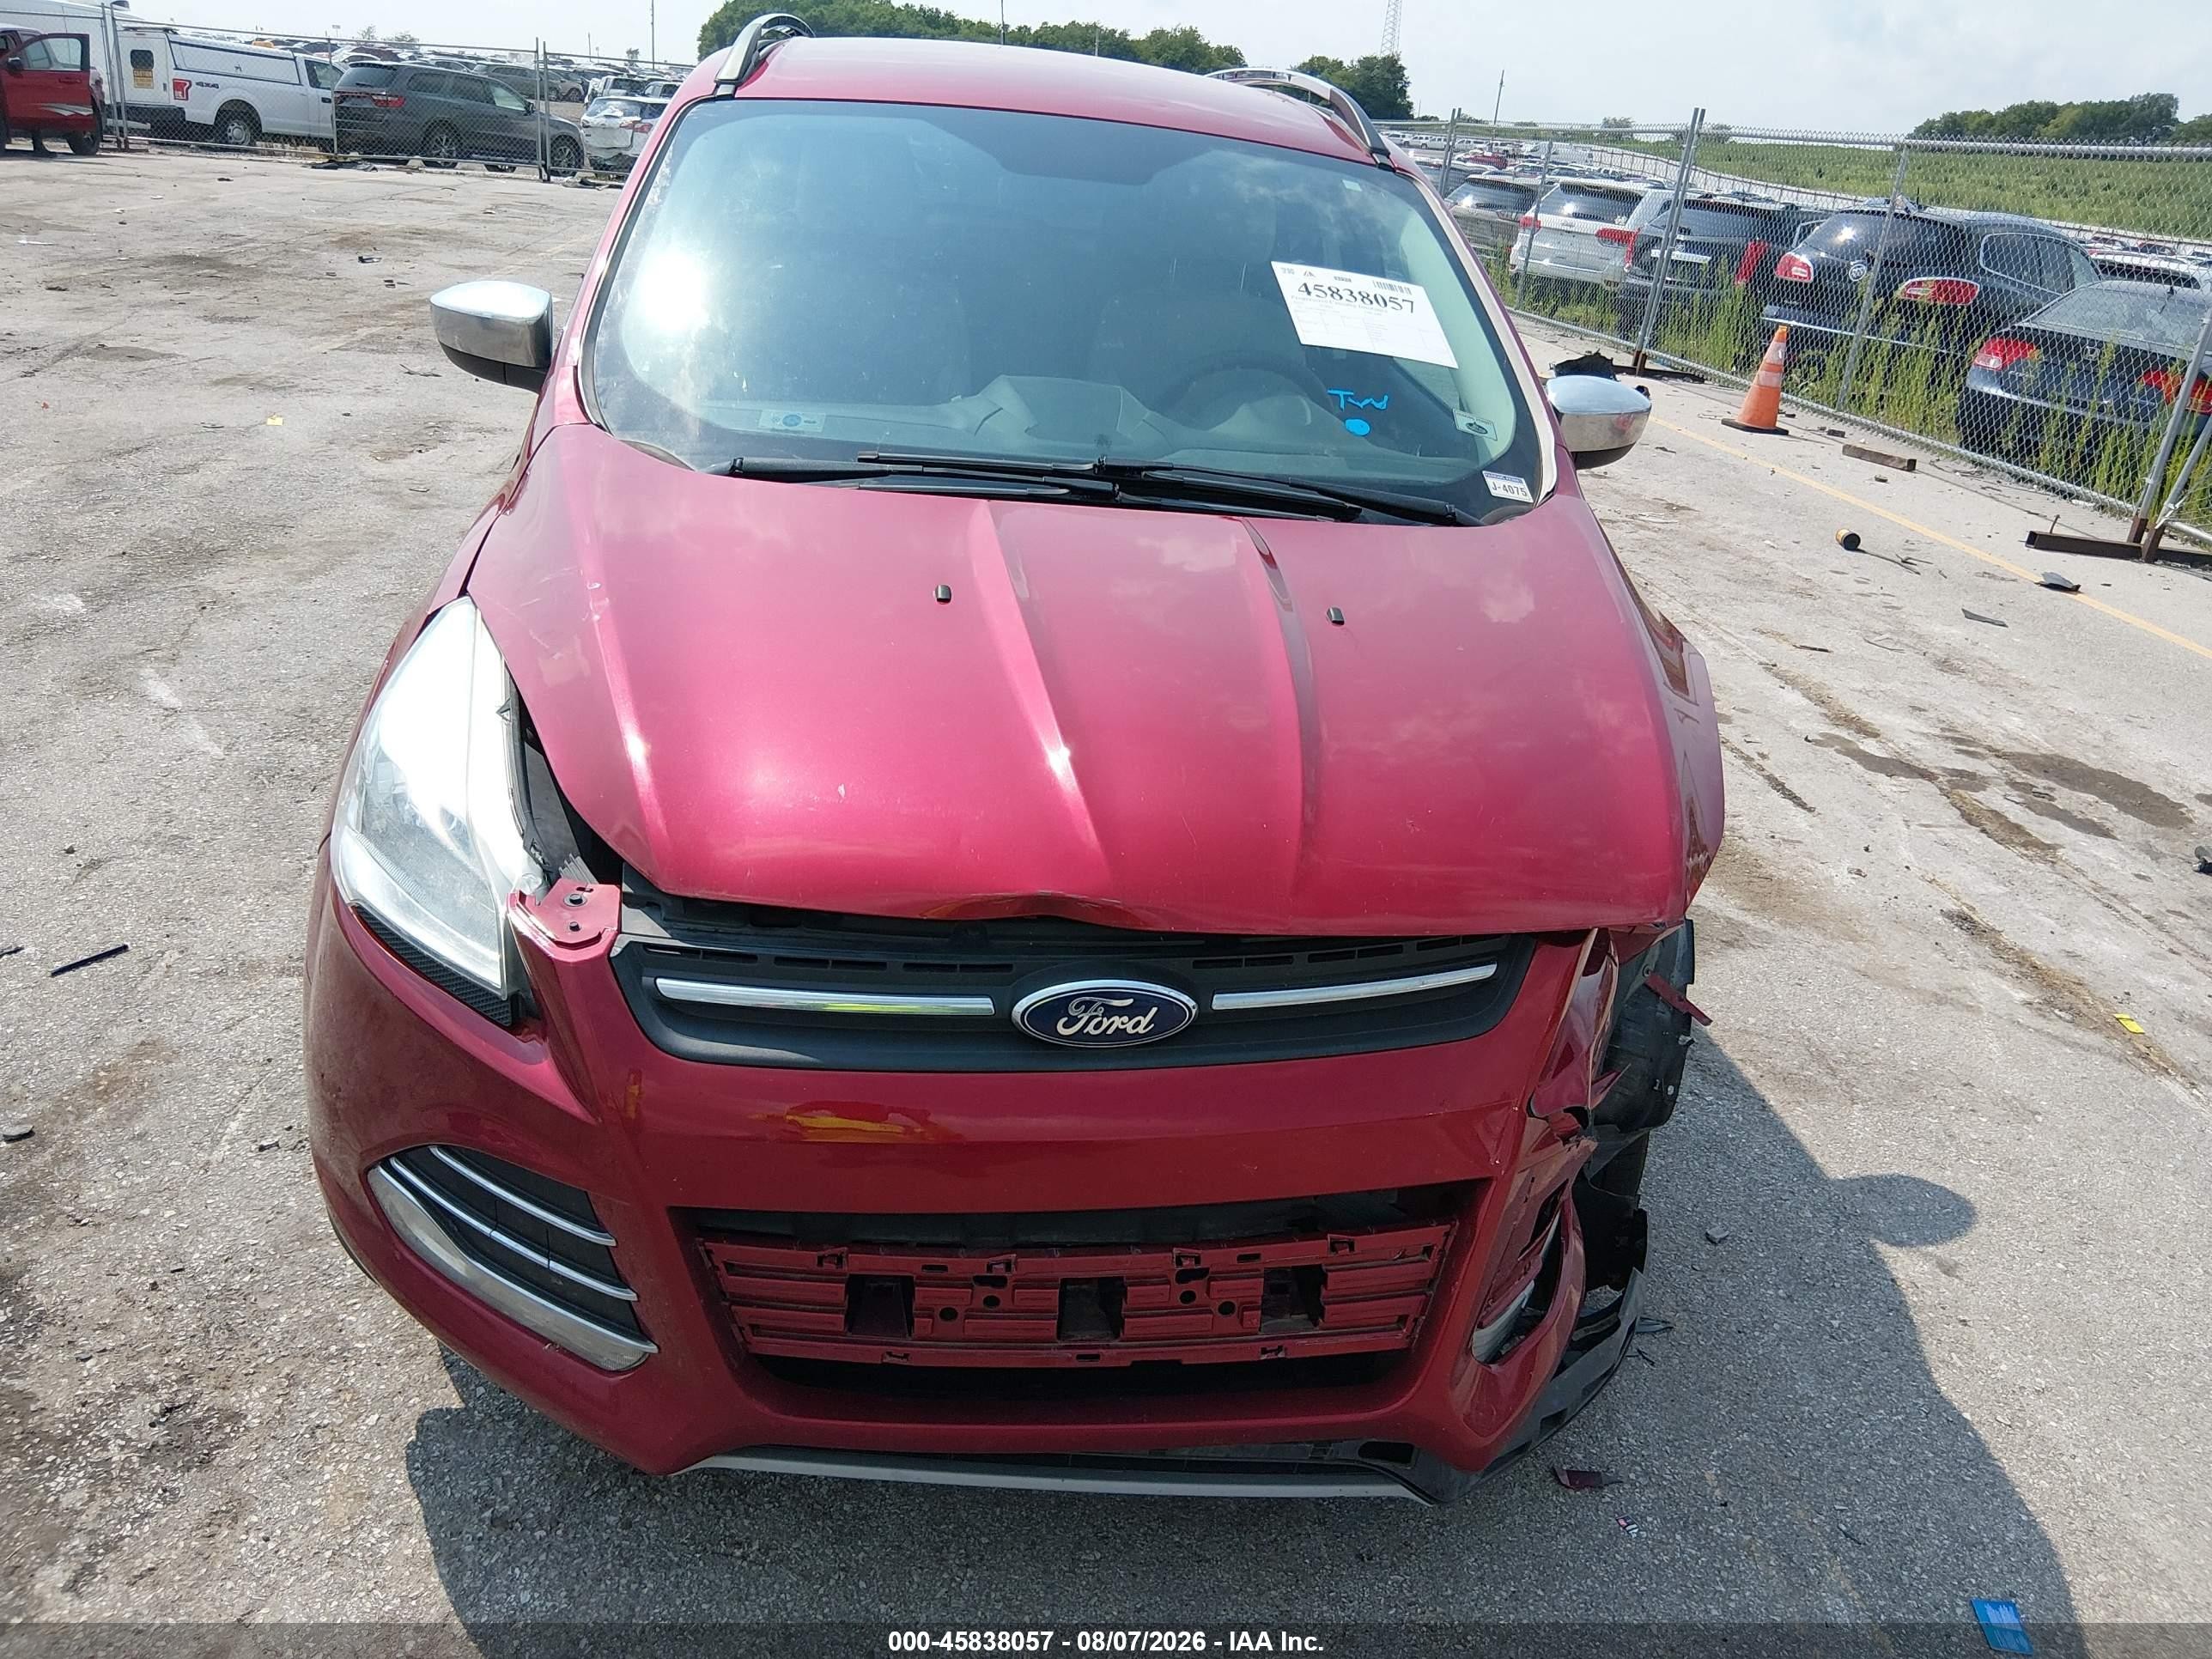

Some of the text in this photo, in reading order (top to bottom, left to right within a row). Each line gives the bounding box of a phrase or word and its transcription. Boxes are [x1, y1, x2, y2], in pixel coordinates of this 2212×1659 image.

[1297, 282, 1414, 313] 45838057
[1492, 481, 1528, 497] J-4075
[1056, 996, 1158, 1036] Ford
